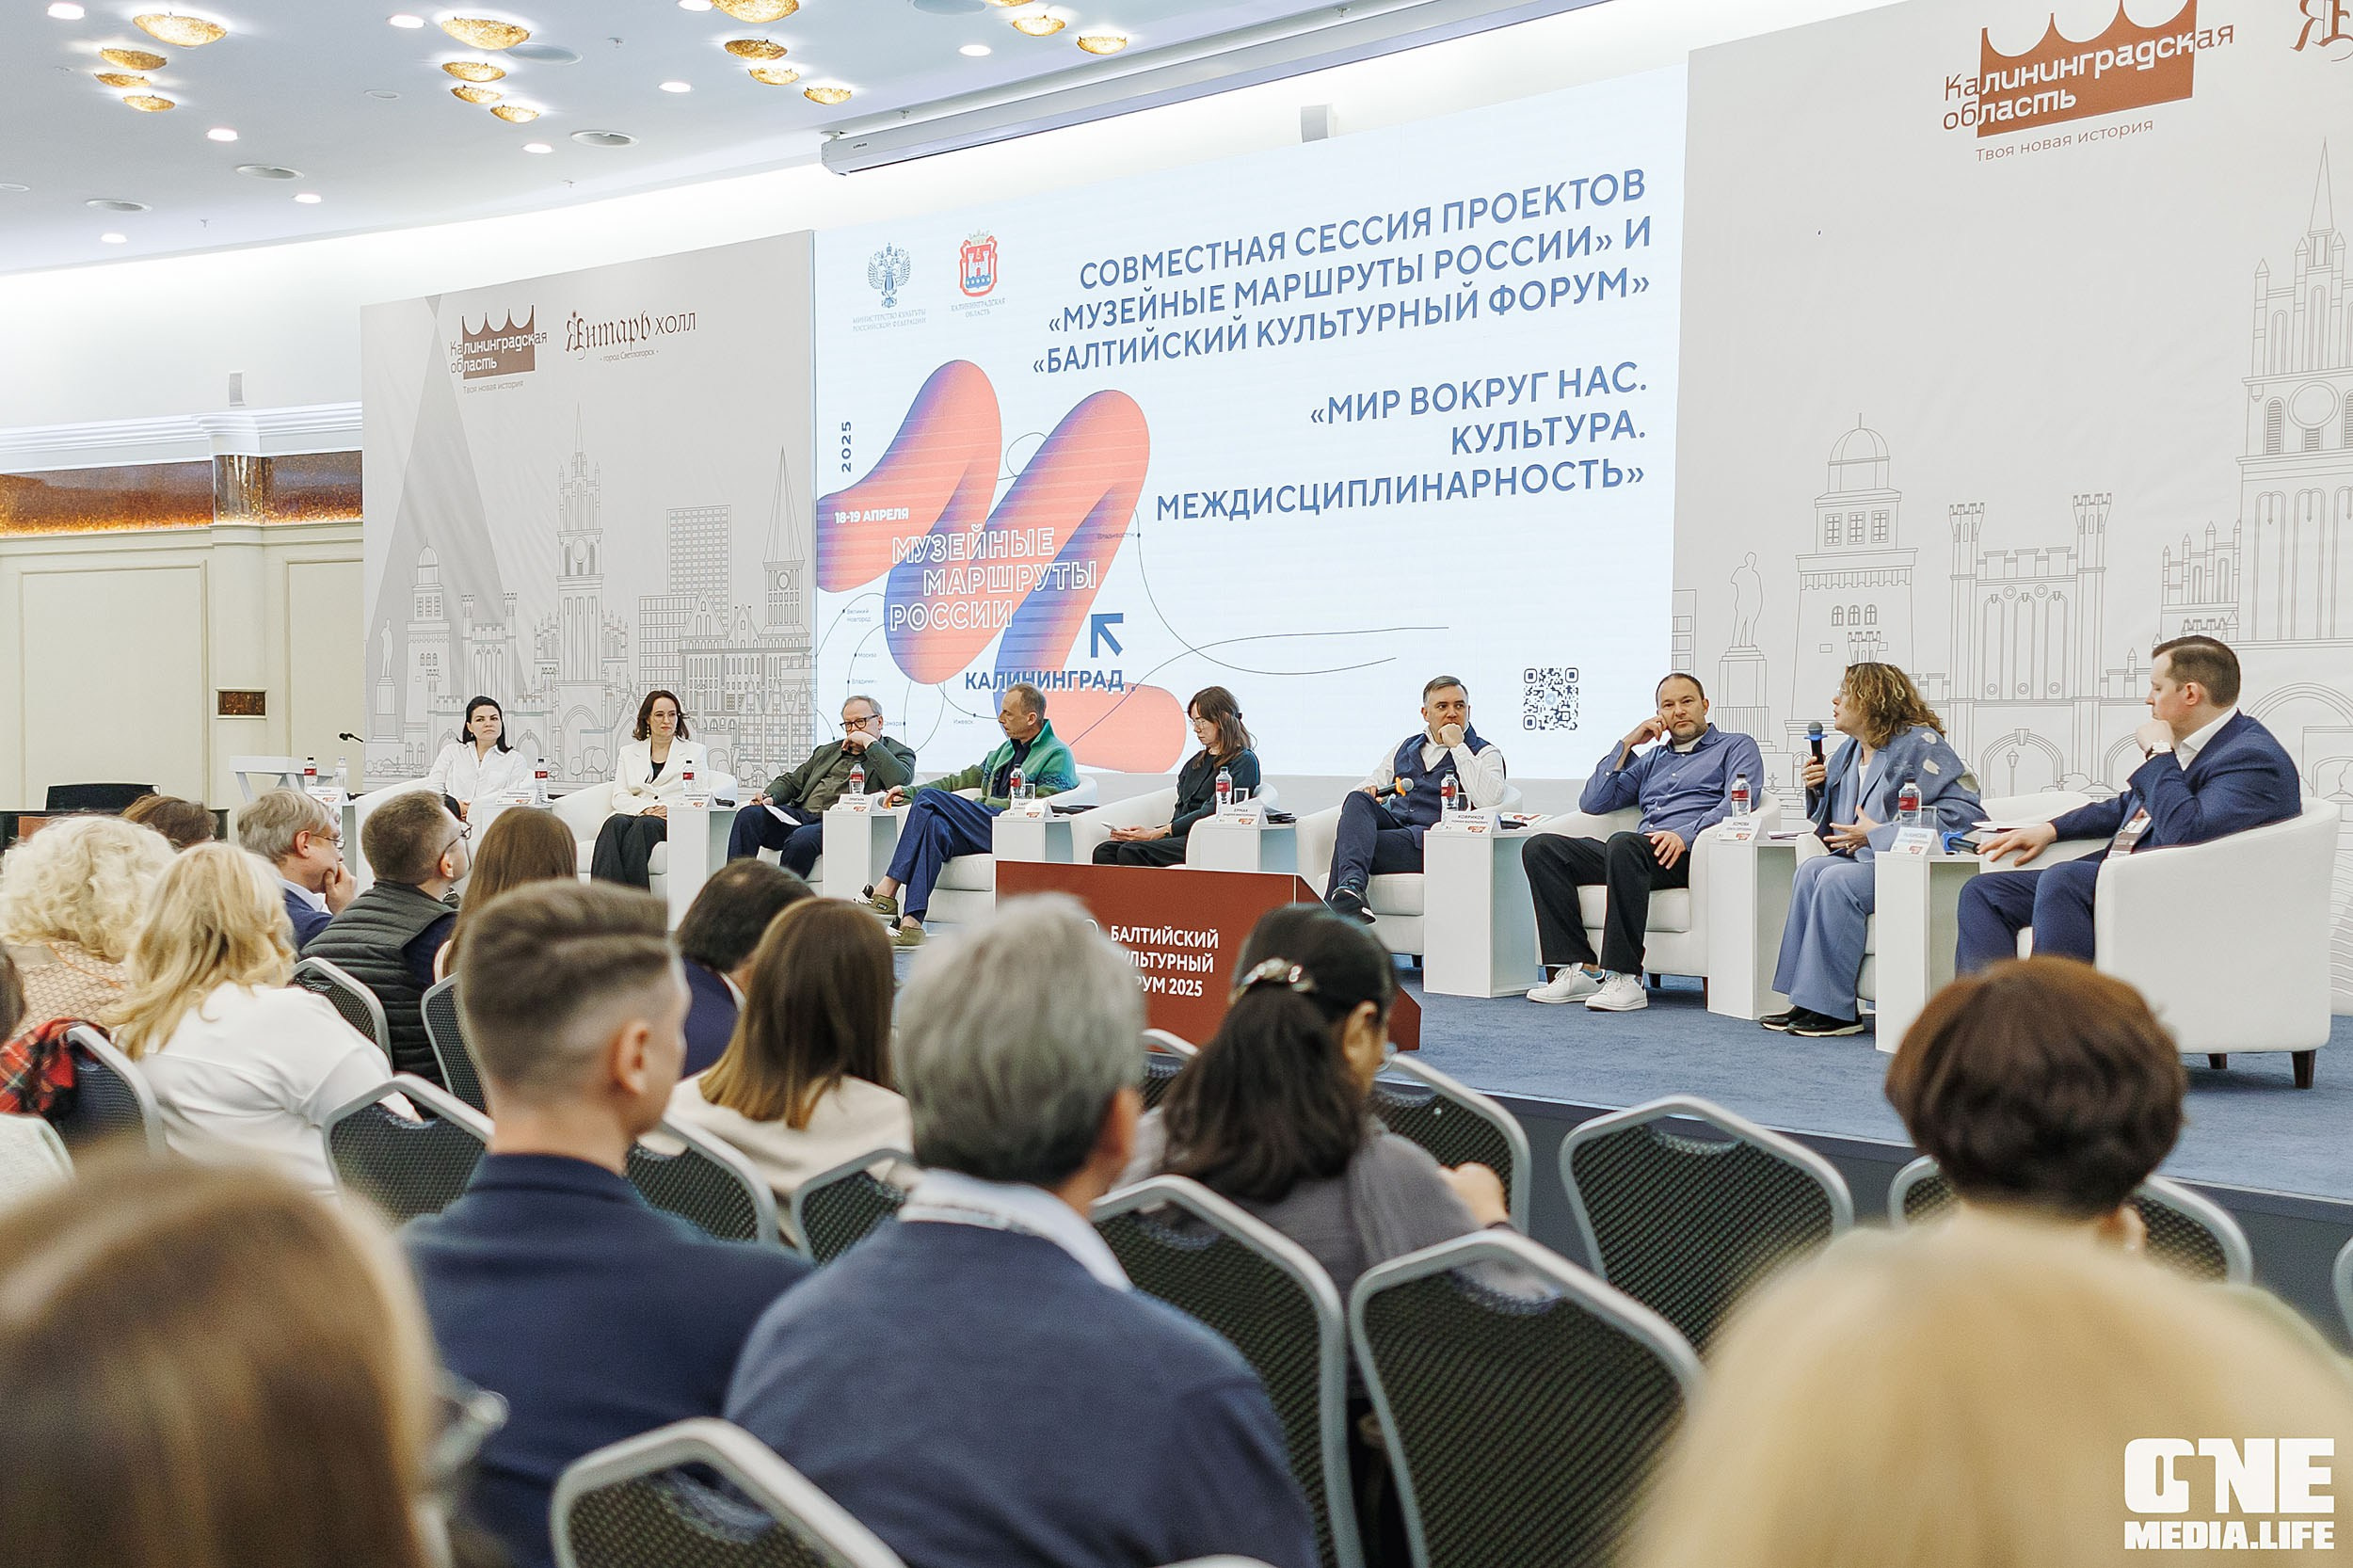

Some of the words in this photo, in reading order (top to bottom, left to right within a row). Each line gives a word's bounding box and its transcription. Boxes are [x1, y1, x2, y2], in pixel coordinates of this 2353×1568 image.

[1945, 24, 2234, 102] Калининградская
[1943, 88, 2076, 130] область
[1976, 145, 2014, 162] Твоя
[2020, 135, 2073, 153] новая
[2077, 120, 2153, 145] история
[1080, 232, 1286, 289] СОВМЕСТНАЯ
[1295, 206, 1431, 258] СЕССИЯ
[1443, 168, 1645, 233] ПРОЕКТОВ
[1048, 284, 1225, 332] «МУЗЕЙНЫЕ
[1235, 253, 1423, 309] МАРШРУТЫ
[1434, 225, 1612, 280] РОССИИ»
[1625, 216, 1651, 249] И
[951, 297, 1006, 312] КАЛИНИНГРАДСКАЯ
[965, 309, 990, 318] ОБЛАСТЬ
[1033, 315, 1247, 374] «БАЛТИЙСКИЙ
[1257, 280, 1478, 348] КУЛЬТУРНЫЙ
[1489, 267, 1650, 315] ФОРУМ»
[654, 312, 696, 335] холл
[450, 331, 548, 357] Калининградская
[450, 357, 498, 374] область
[478, 383, 496, 392] новая
[497, 380, 523, 390] история
[1310, 390, 1401, 424] «МИР
[1410, 371, 1549, 416] ВОКРУГ
[1559, 361, 1647, 399] НАС.
[840, 421, 852, 473] 2025
[1452, 409, 1646, 456] КУЛЬТУРА.
[1157, 457, 1645, 521] МЕЖДИСЦИПЛИНАРНОСТЬ»
[862, 507, 909, 522] АПРЕЛЯ
[891, 523, 1055, 565] МУЗЕЙНЫЕ
[922, 560, 1098, 597] МАРШРУТЫ
[889, 600, 1013, 632] РОССИИ
[965, 669, 1126, 694] КАЛИНИНГРАД
[1111, 924, 1220, 950] БАЛТИЙСКИЙ
[1121, 950, 1214, 973] УЛЬТУРНЫЙ
[1168, 977, 1203, 998] 2025
